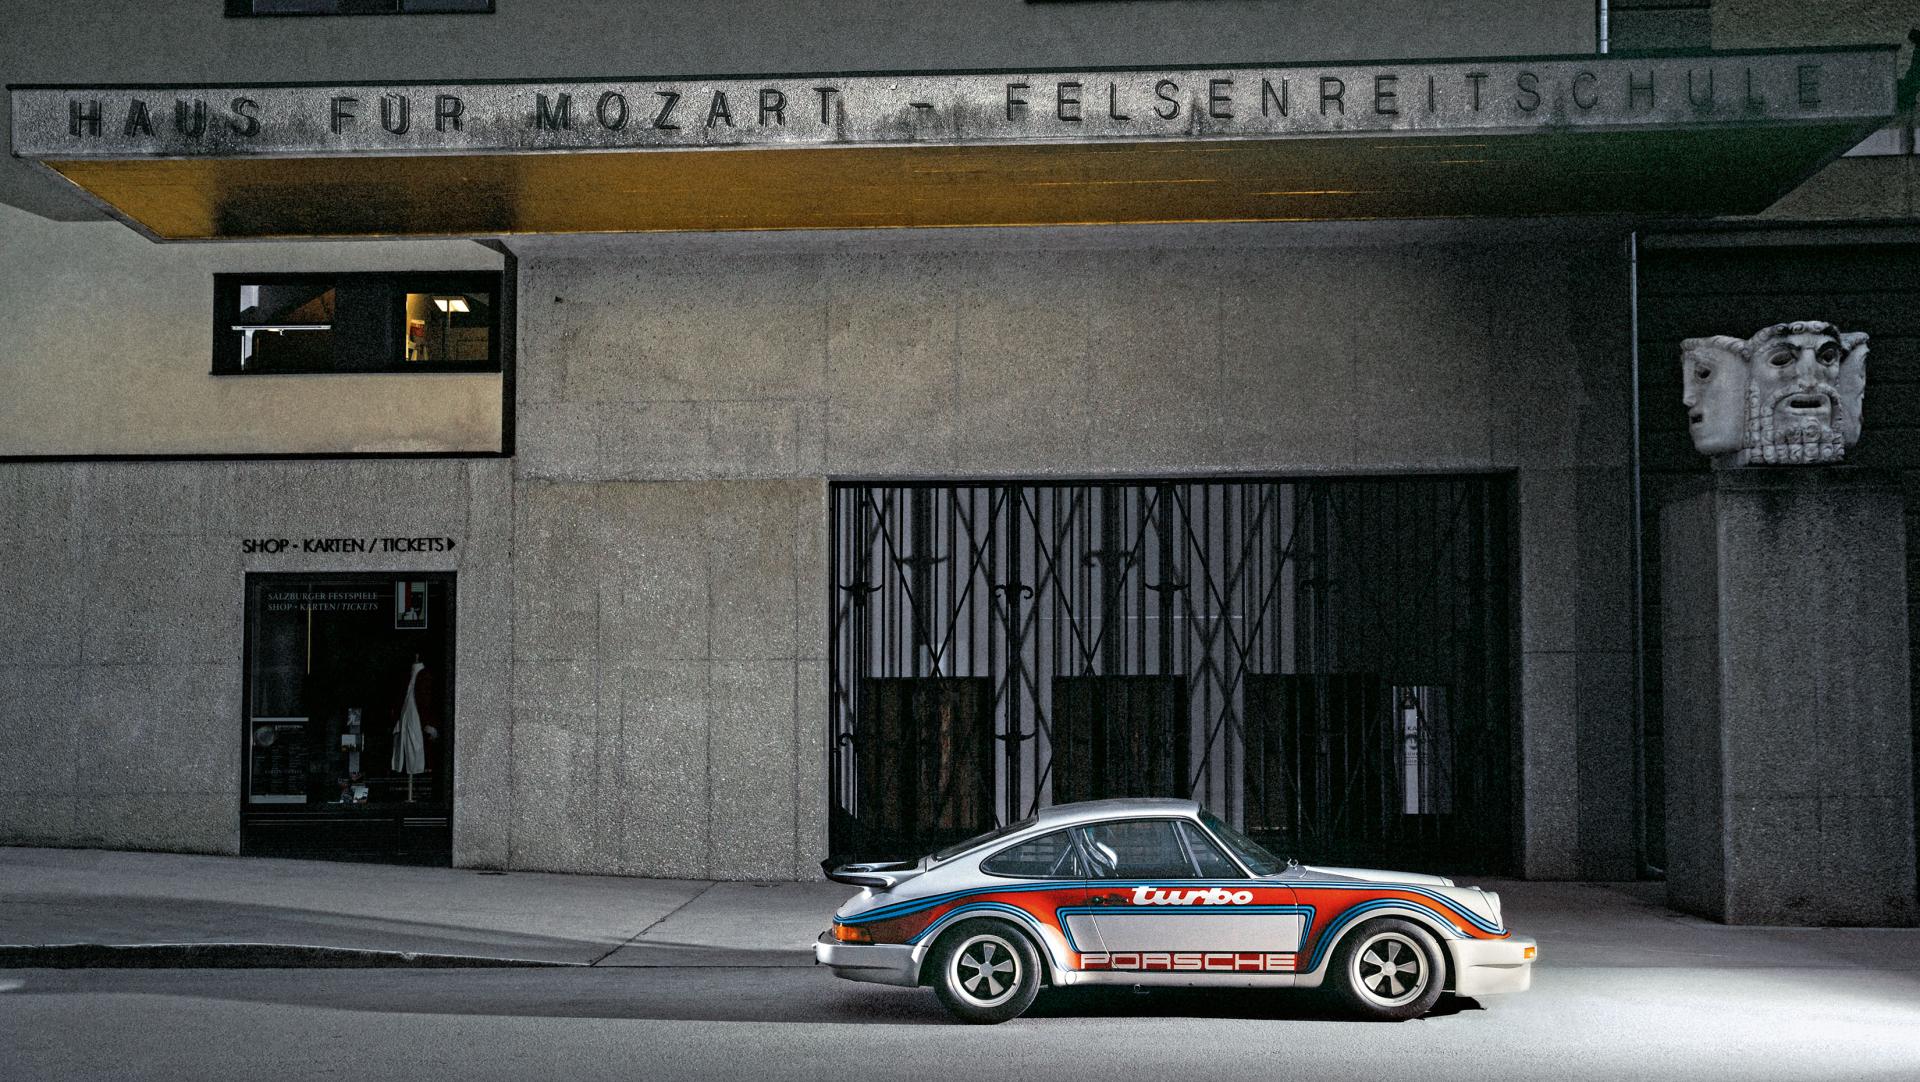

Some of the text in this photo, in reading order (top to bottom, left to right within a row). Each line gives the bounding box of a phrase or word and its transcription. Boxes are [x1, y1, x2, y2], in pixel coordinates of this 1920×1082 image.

[68, 96, 261, 138] HAUS
[330, 94, 466, 135] FÜR
[535, 87, 838, 131] MOZART
[1006, 64, 1822, 122] FELSENREITSCHULE
[242, 539, 289, 554] SHOP
[303, 538, 364, 553] KARTEN
[382, 537, 444, 552] TICKETS
[268, 591, 378, 601] SALZBURGER FESTSPIELE
[268, 603, 293, 611] SHOP
[1131, 886, 1254, 905] turbo
[1080, 953, 1296, 971] PORSCHE
